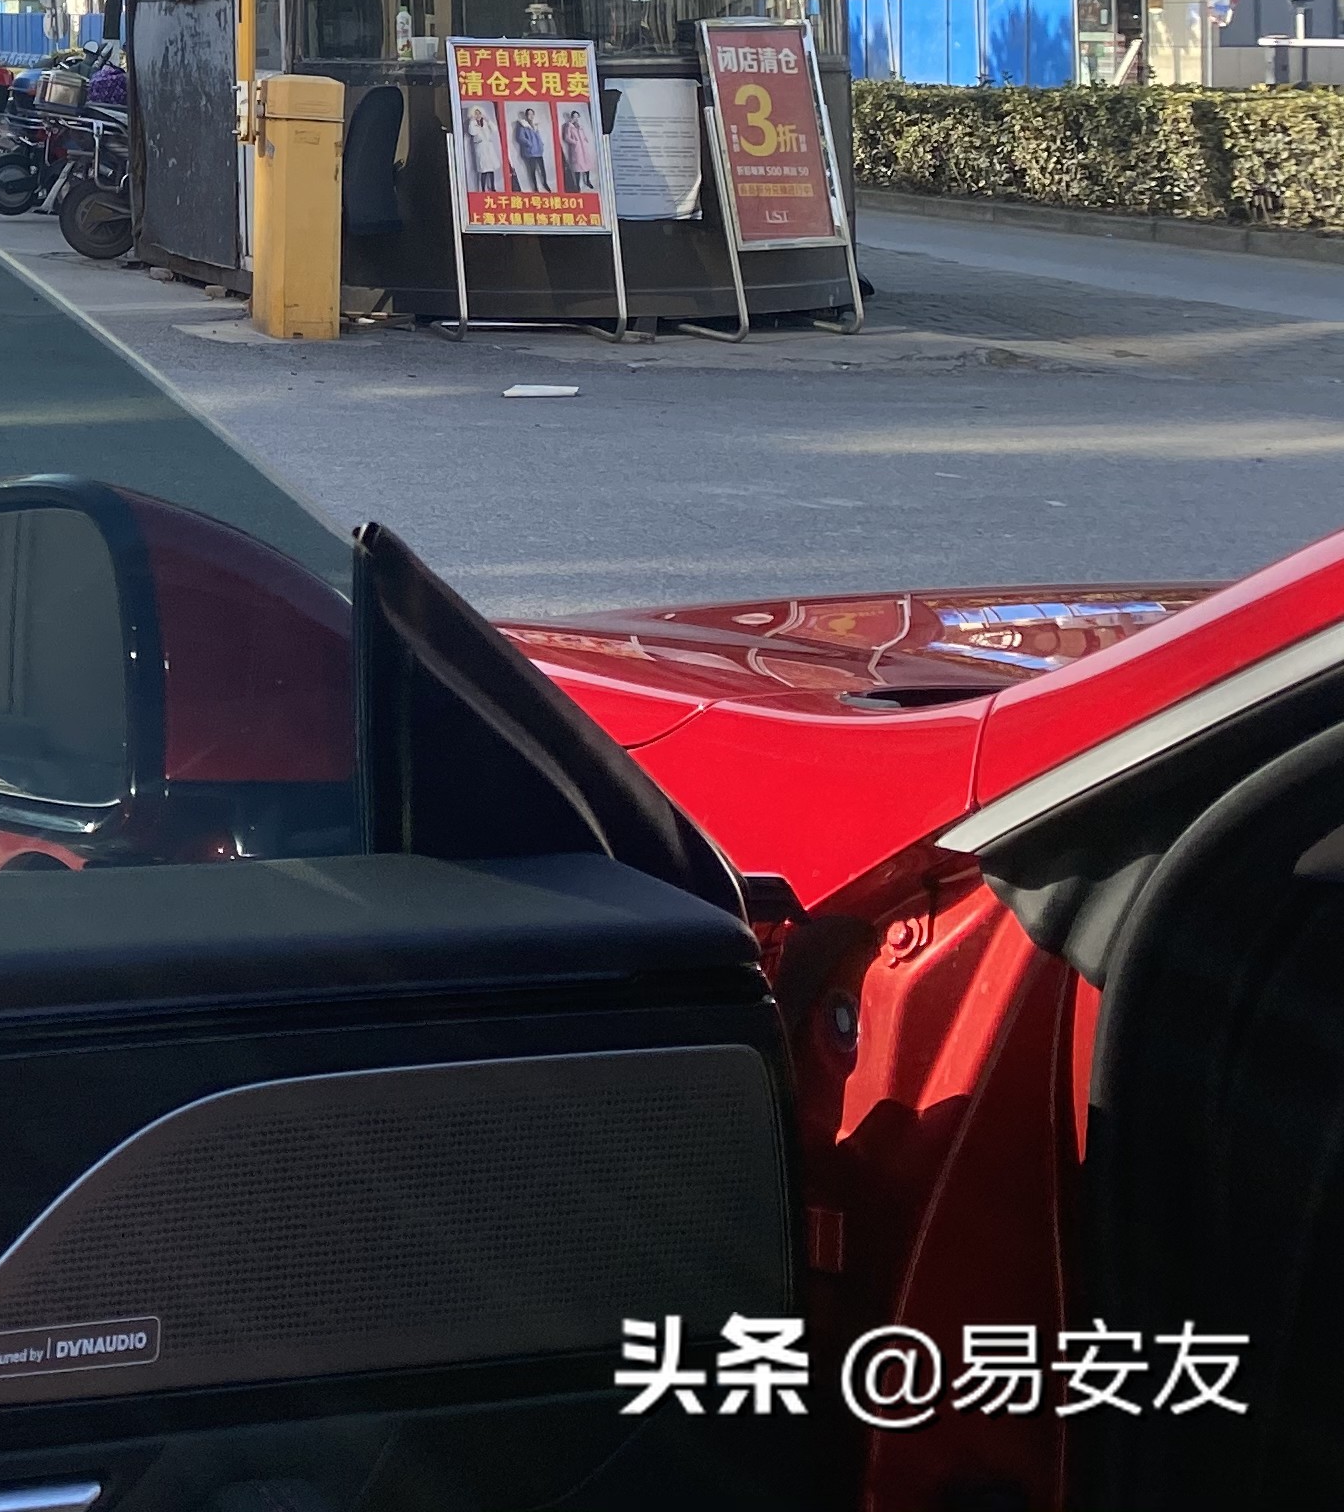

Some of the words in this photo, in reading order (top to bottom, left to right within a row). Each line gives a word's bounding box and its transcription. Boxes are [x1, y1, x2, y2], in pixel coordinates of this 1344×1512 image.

[457, 48, 588, 68] 自产自销羽绒服
[717, 46, 799, 74] 闭店清仓
[459, 70, 591, 97] 清仓大甩卖
[734, 83, 799, 157] 3折
[484, 195, 584, 210] 九干路1号3楼301
[29, 1348, 44, 1363] by
[56, 1331, 148, 1359] DYNAUDIO
